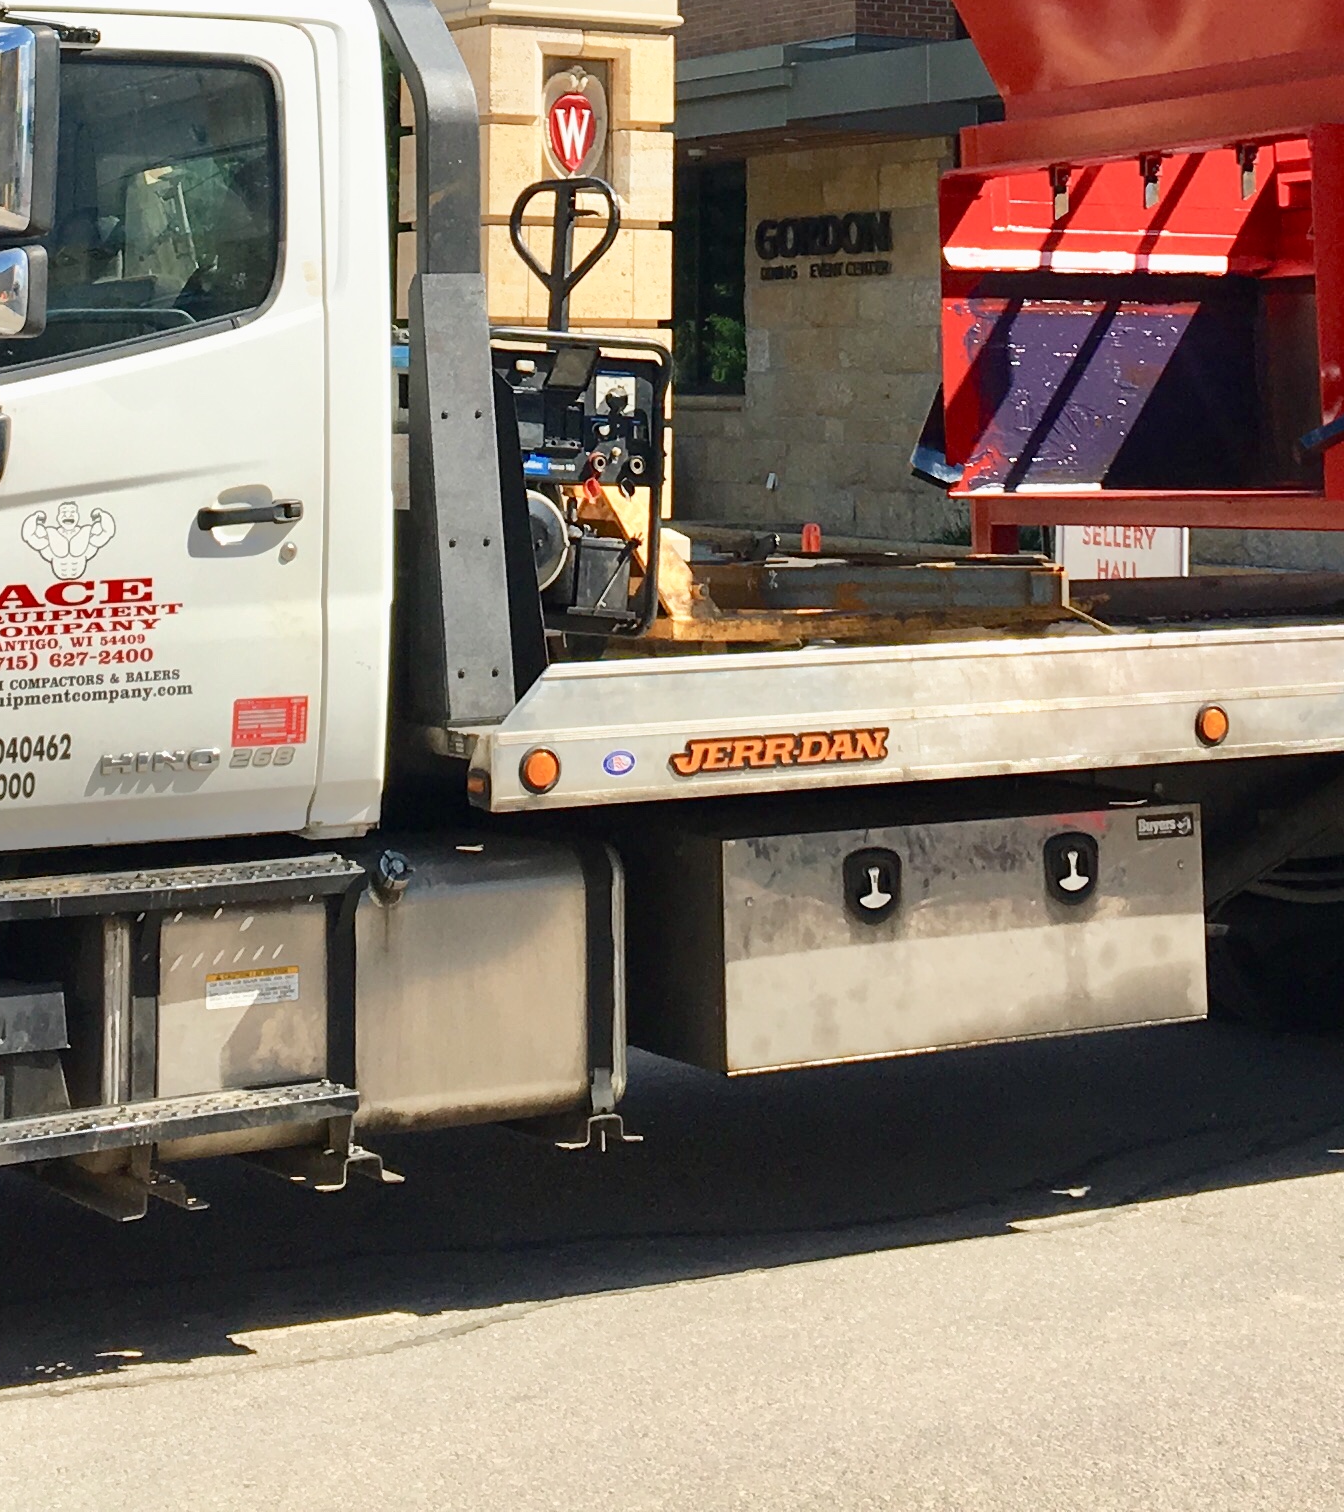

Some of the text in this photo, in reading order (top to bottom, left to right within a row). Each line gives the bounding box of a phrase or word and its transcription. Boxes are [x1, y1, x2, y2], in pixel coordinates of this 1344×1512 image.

[554, 106, 591, 160] W
[756, 211, 893, 259] GORDON
[1082, 526, 1156, 550] SELLERY
[1097, 559, 1137, 579] HALL
[70, 636, 93, 648] WI
[100, 633, 146, 646] 54409
[49, 647, 154, 668] 627-2400
[10, 674, 104, 691] COMPACTORS
[110, 673, 120, 684] &
[126, 669, 180, 683] BALERS
[100, 746, 295, 776] HINO 268
